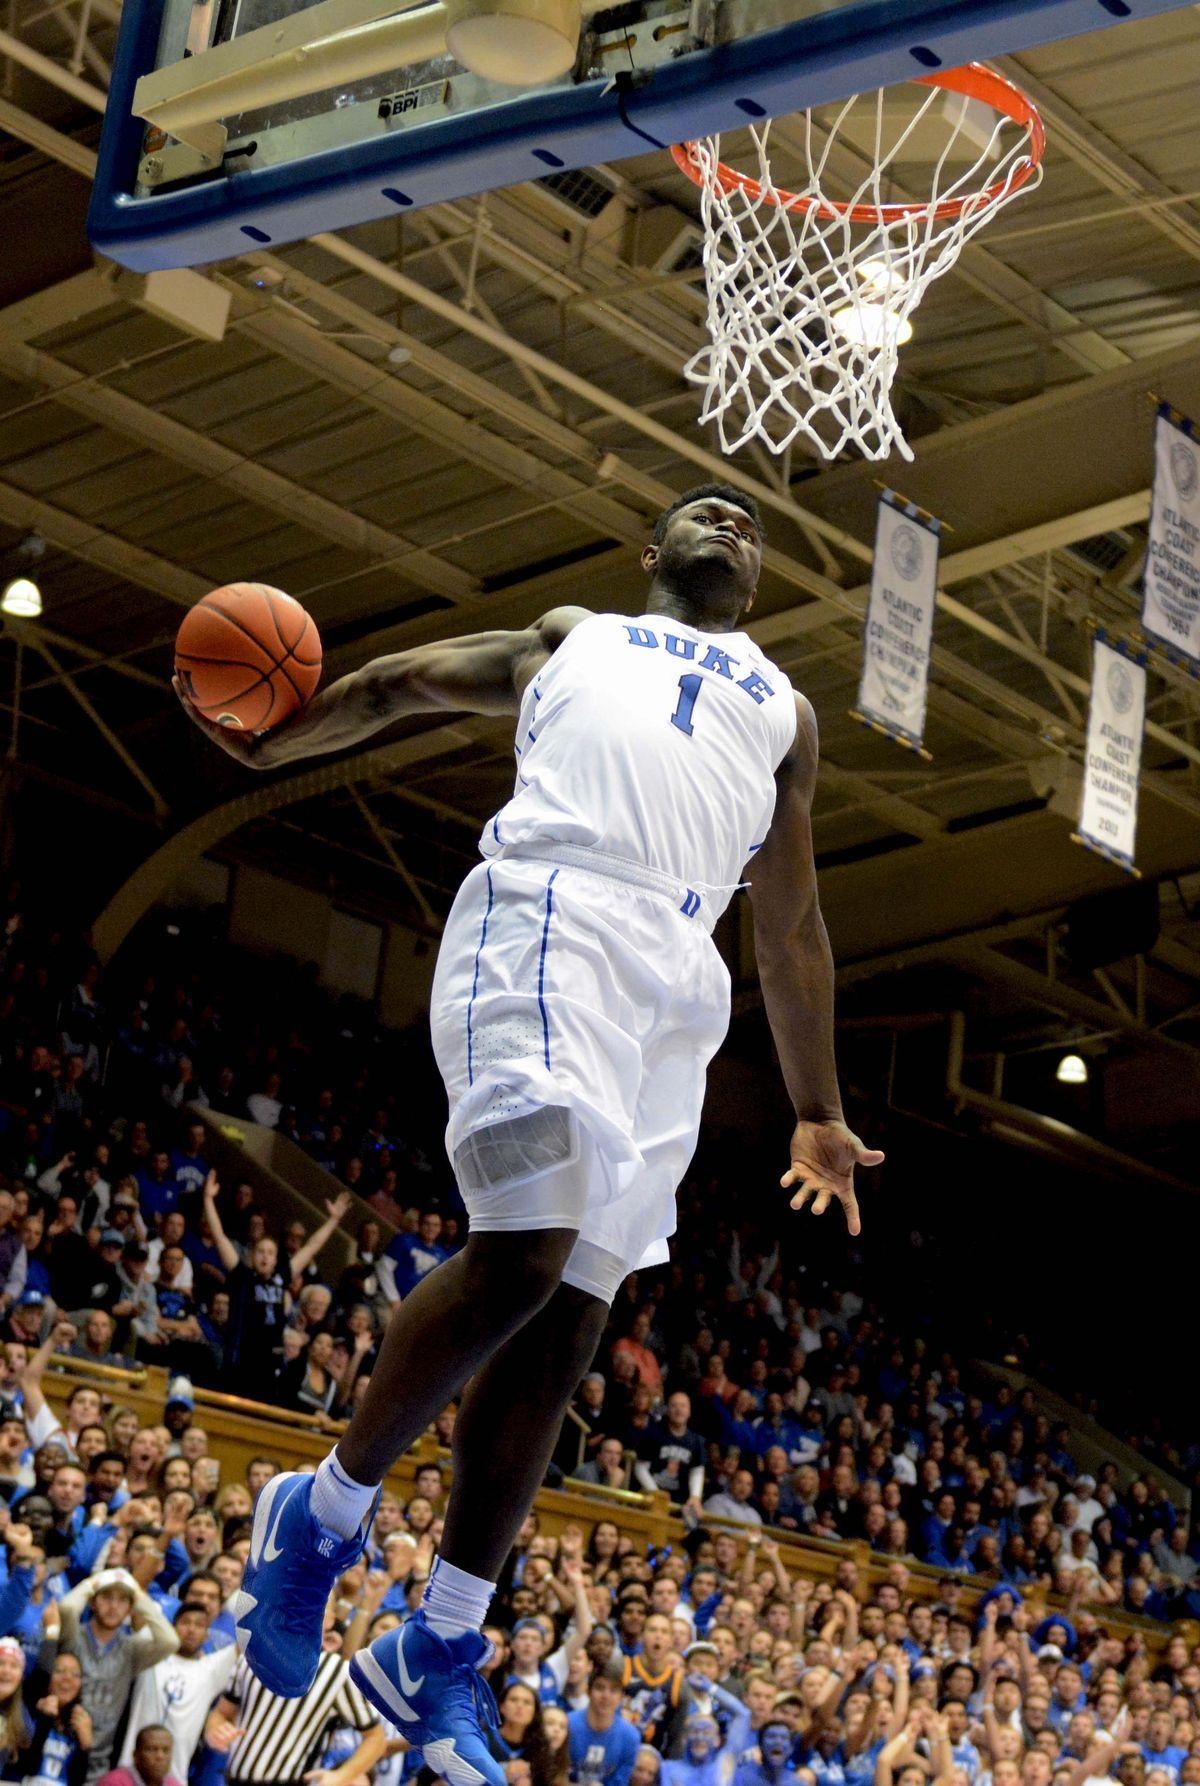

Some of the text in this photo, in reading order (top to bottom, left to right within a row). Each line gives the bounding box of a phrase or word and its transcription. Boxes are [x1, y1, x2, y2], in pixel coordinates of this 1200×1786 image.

[1165, 529, 1195, 557] COAST
[883, 588, 922, 621] ATLANTIC
[623, 625, 775, 705] DUKE
[671, 673, 703, 737] 1
[1106, 742, 1130, 766] COAST
[680, 888, 701, 918] D
